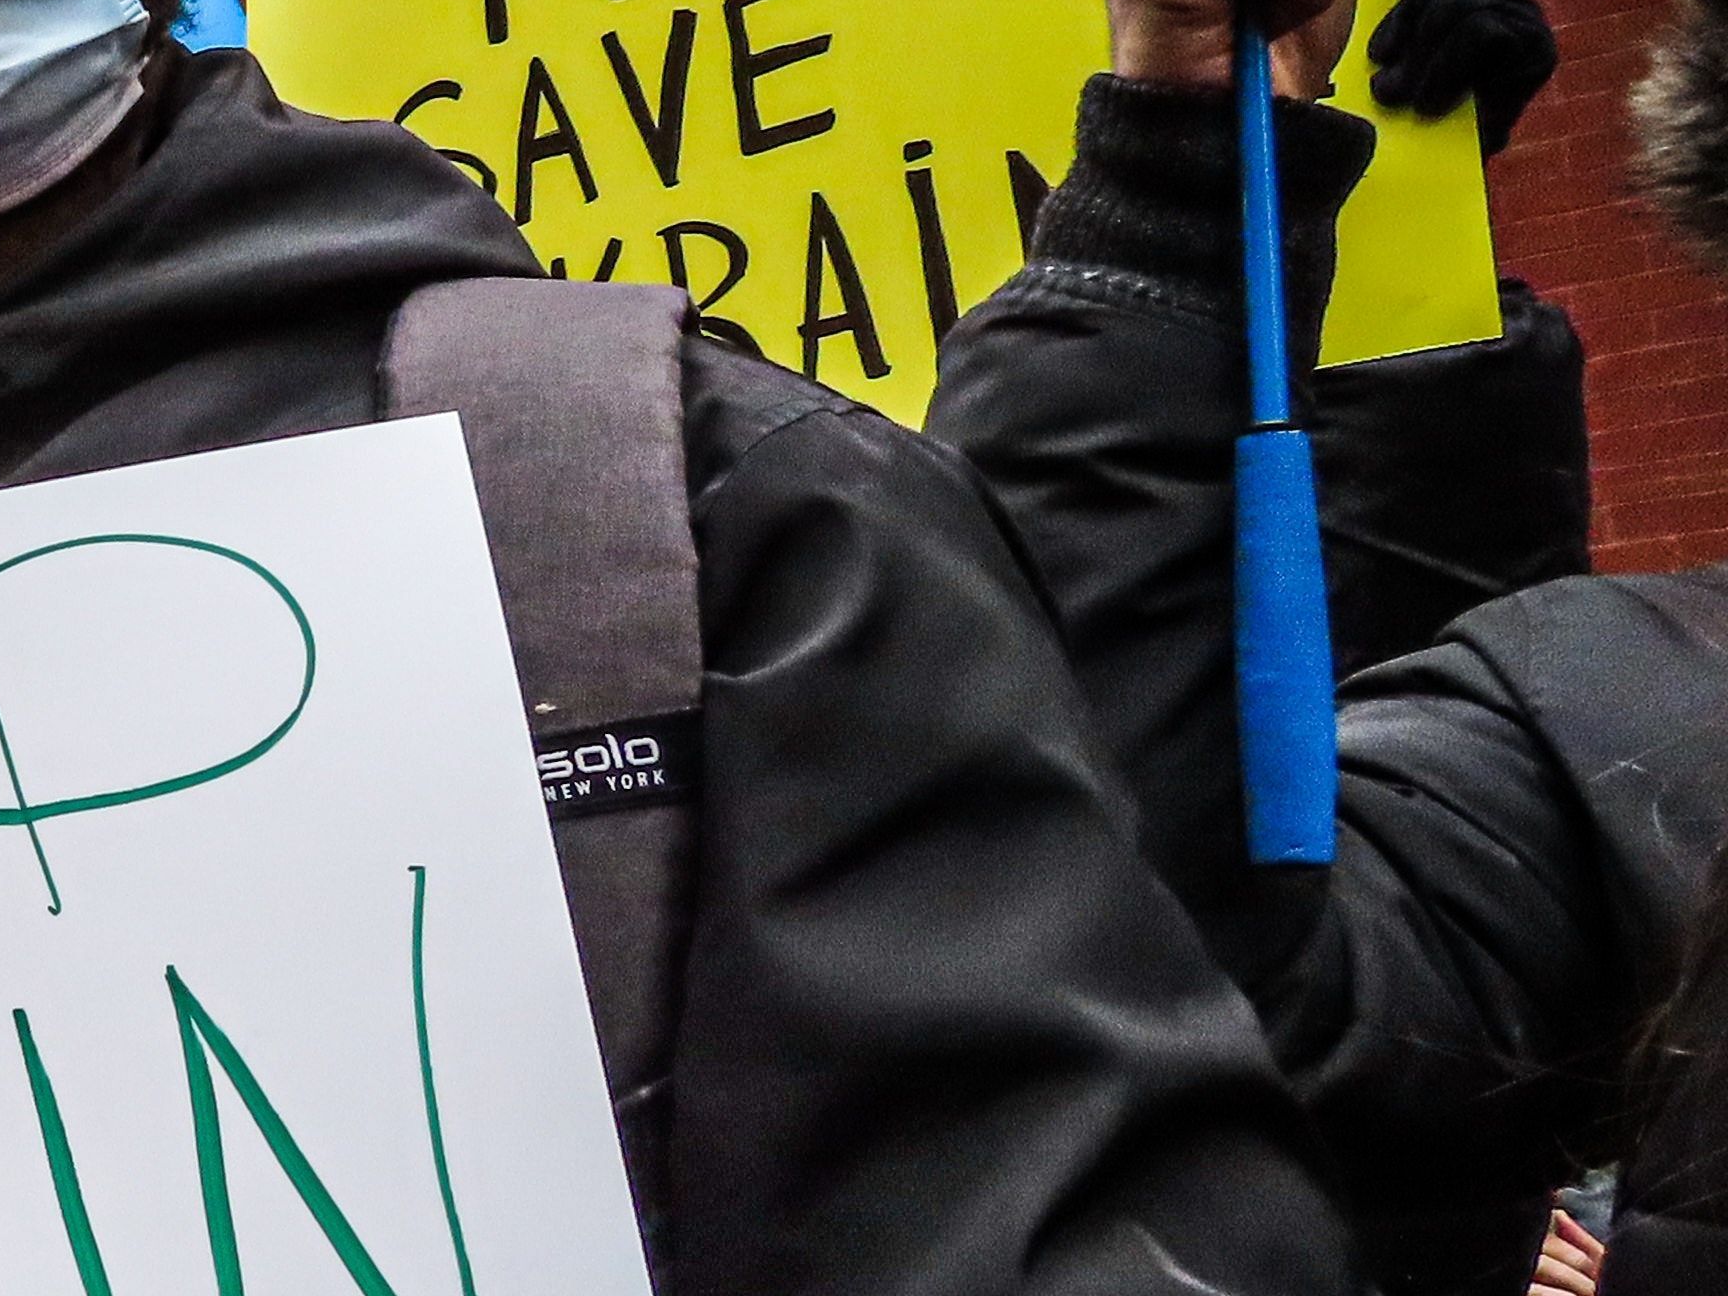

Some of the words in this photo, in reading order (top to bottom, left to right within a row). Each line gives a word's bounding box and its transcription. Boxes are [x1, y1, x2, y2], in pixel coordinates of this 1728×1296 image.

[537, 733, 660, 780] solo
[543, 779, 591, 802] NEW
[606, 768, 666, 792] YORK
